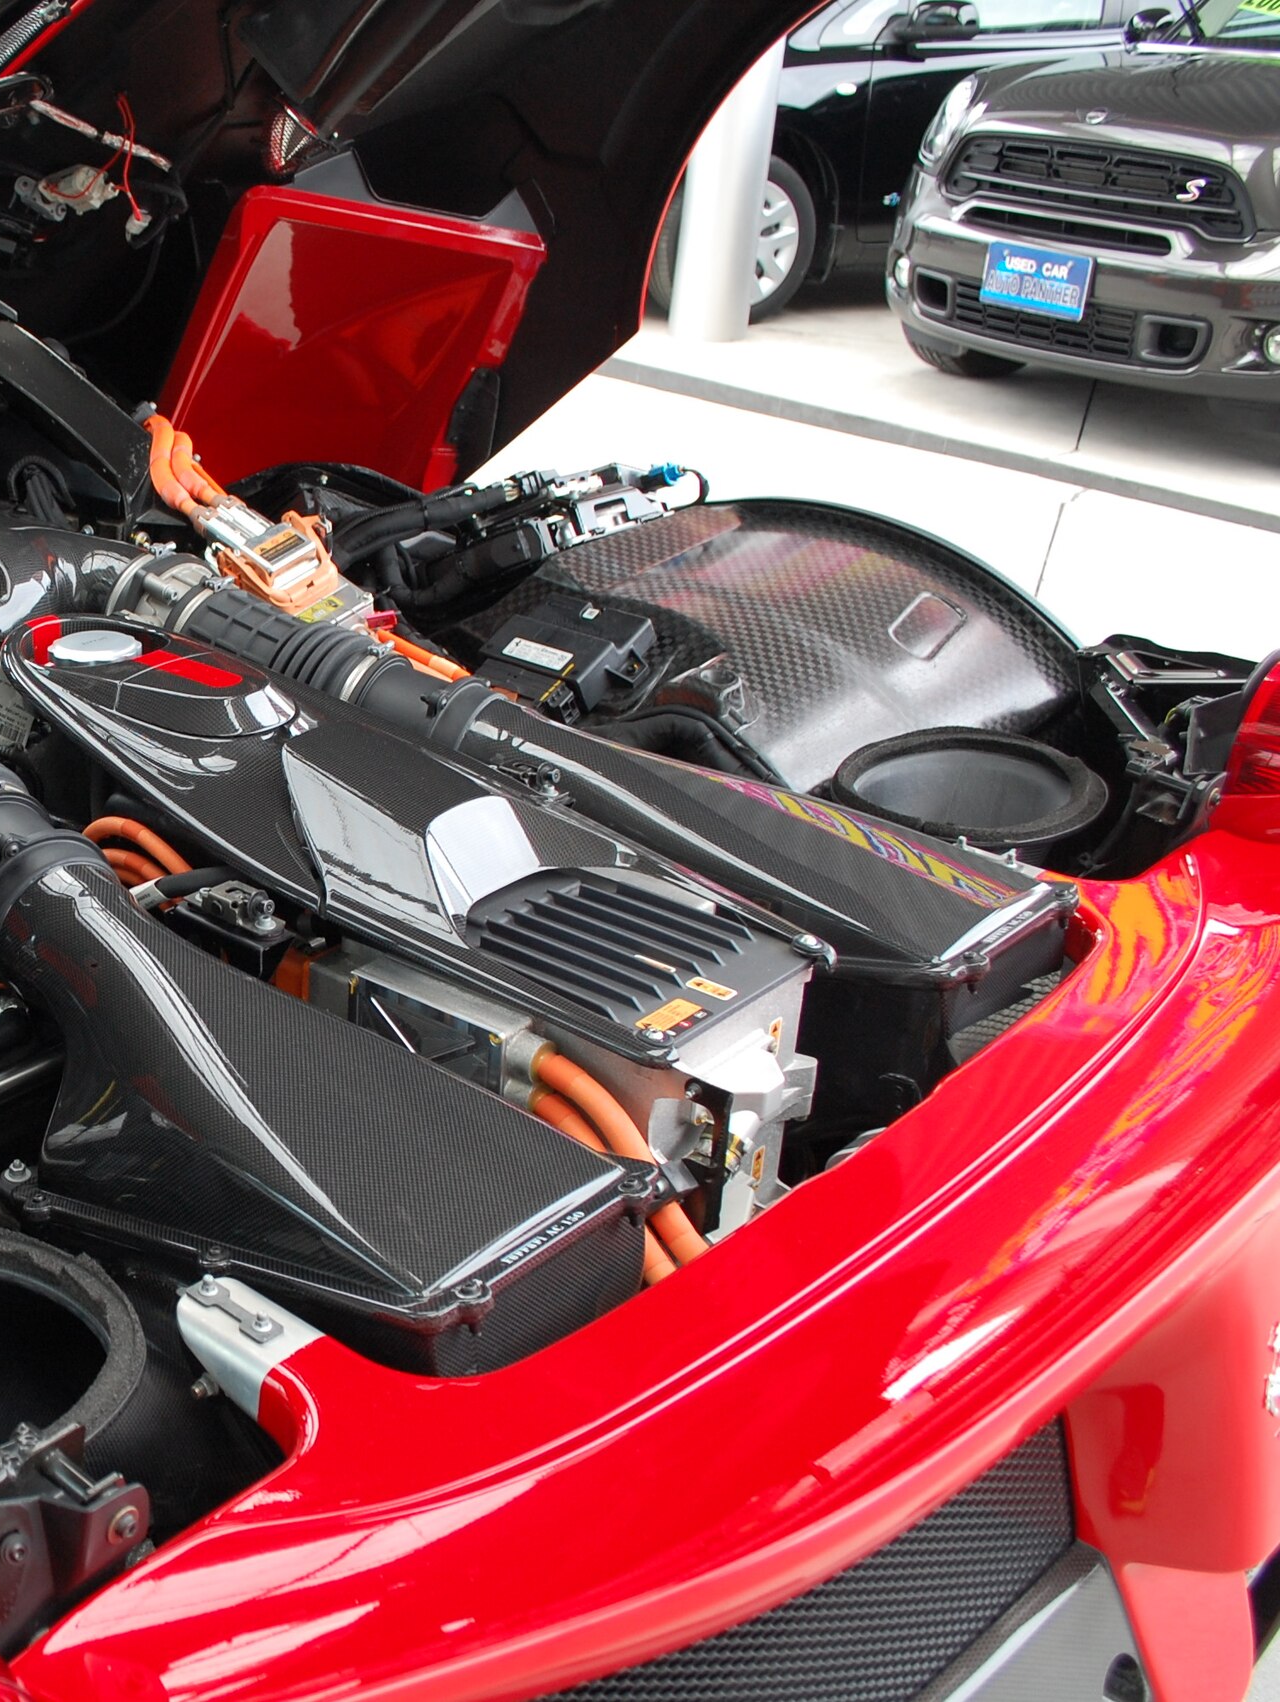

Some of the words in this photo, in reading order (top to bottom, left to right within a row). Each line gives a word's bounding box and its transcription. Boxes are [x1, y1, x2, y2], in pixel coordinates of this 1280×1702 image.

[1176, 179, 1206, 203] S
[1005, 256, 1036, 273] USED
[1042, 262, 1069, 280] CAR
[986, 269, 1020, 295] AUTO
[1021, 276, 1080, 307] PANTHER
[561, 1211, 585, 1226] 150
